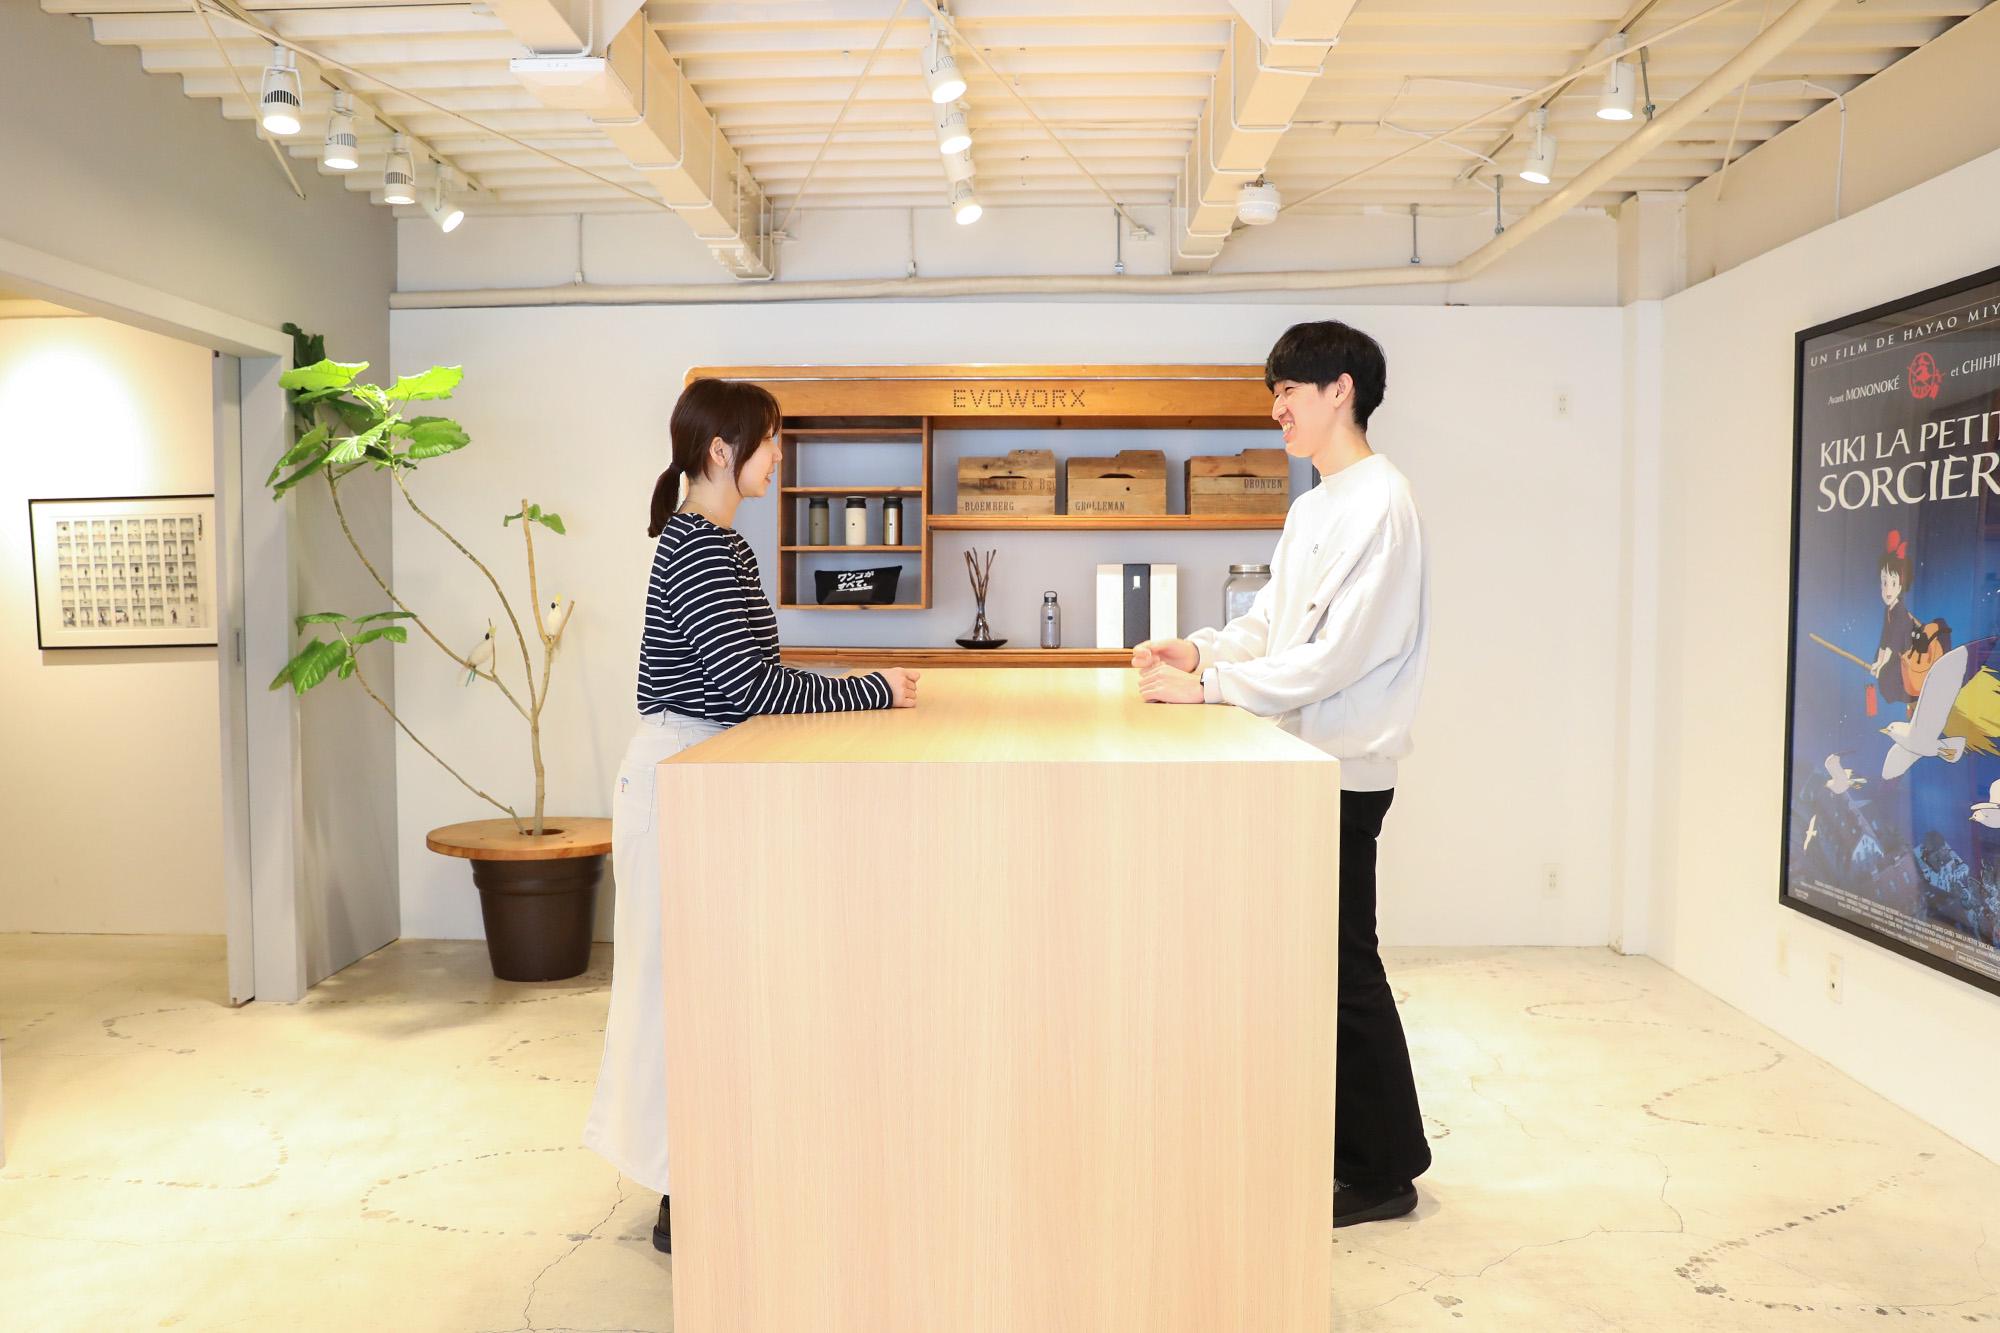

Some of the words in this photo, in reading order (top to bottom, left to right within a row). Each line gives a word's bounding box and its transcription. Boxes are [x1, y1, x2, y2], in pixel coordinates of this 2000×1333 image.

[1810, 353, 1828, 367] UN
[1835, 342, 1868, 360] FILM
[1876, 334, 1895, 348] DE
[1903, 316, 1958, 341] HAYAO
[1950, 367, 1959, 377] et
[1845, 375, 1900, 402] MONONOKÉ
[953, 389, 1085, 408] EVOWORX
[1820, 435, 1866, 468] KIKI
[1876, 428, 1910, 459] LA
[1244, 479, 1282, 489] DRONTEN
[964, 501, 1014, 511] BLOEMBERG
[1075, 501, 1125, 511] GROLLEMAN
[838, 571, 875, 582] ワンコが
